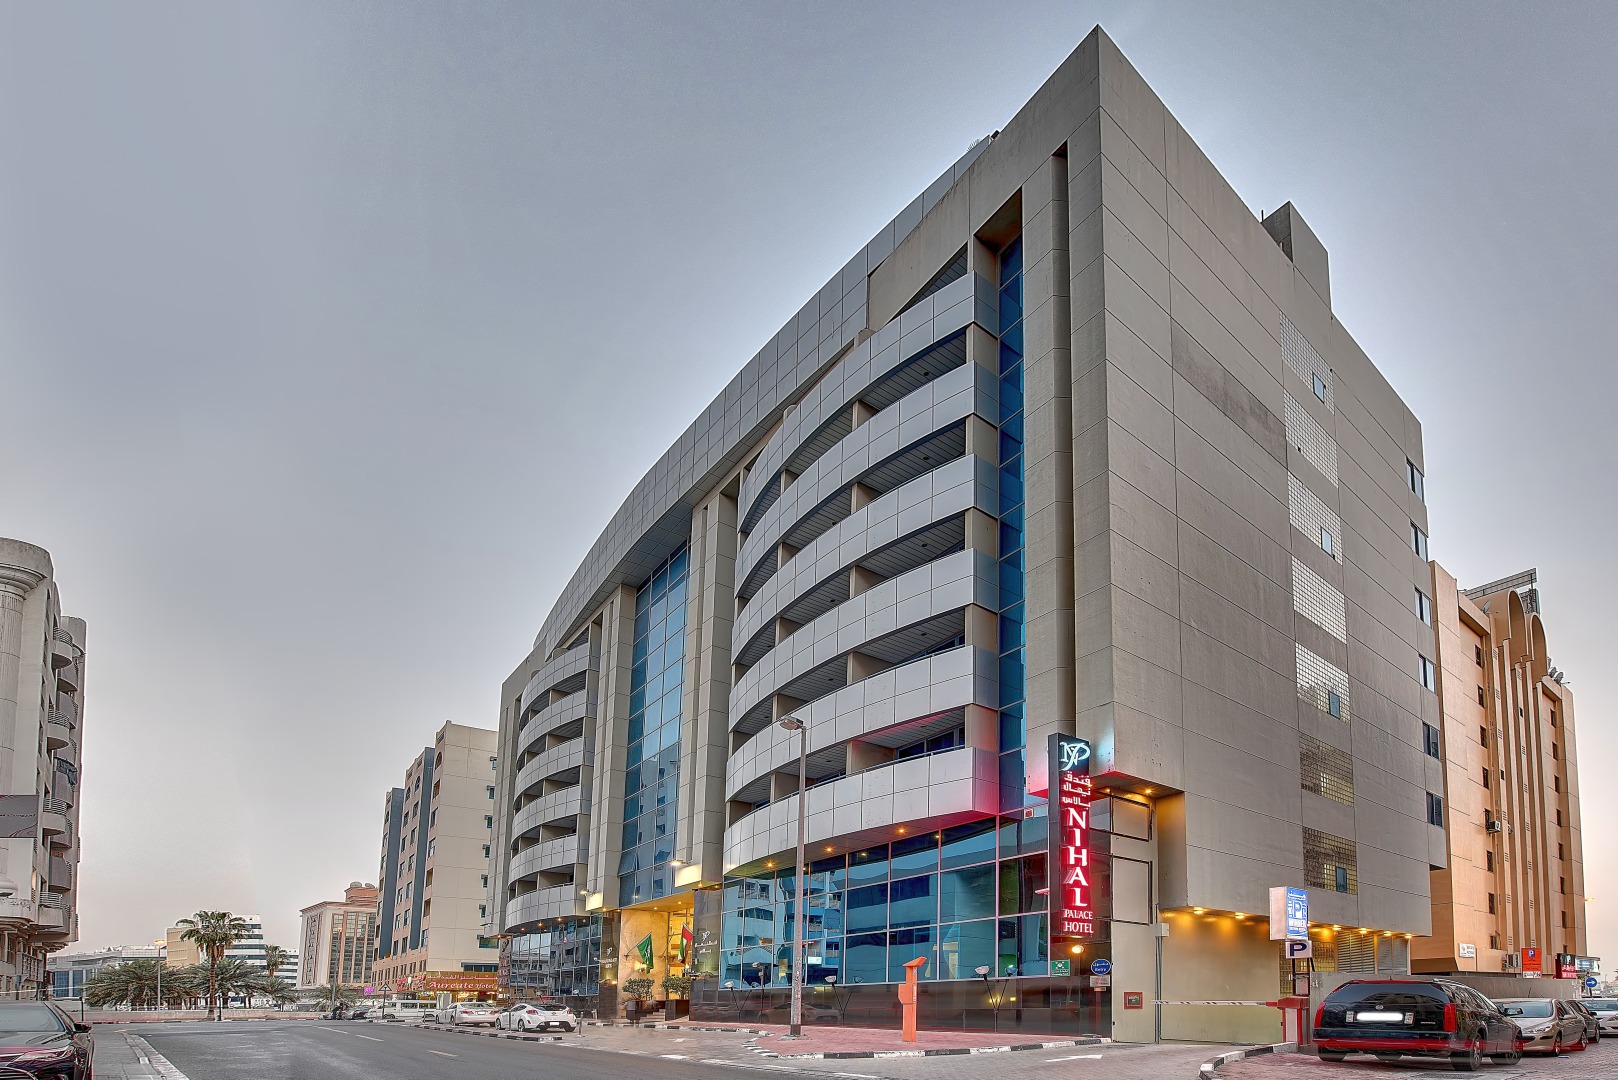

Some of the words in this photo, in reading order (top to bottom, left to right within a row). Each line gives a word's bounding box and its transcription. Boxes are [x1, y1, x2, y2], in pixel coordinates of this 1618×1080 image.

[1064, 771, 1091, 787] فندق
[1063, 782, 1091, 797] نيهال
[1062, 797, 1091, 810] بالاس
[1066, 807, 1088, 907] NIHAL
[1064, 909, 1093, 920] PALACE
[1064, 921, 1094, 933] HOTEL
[1290, 943, 1307, 956] P
[427, 981, 474, 989] Aureate
[475, 982, 495, 990] Hotel
